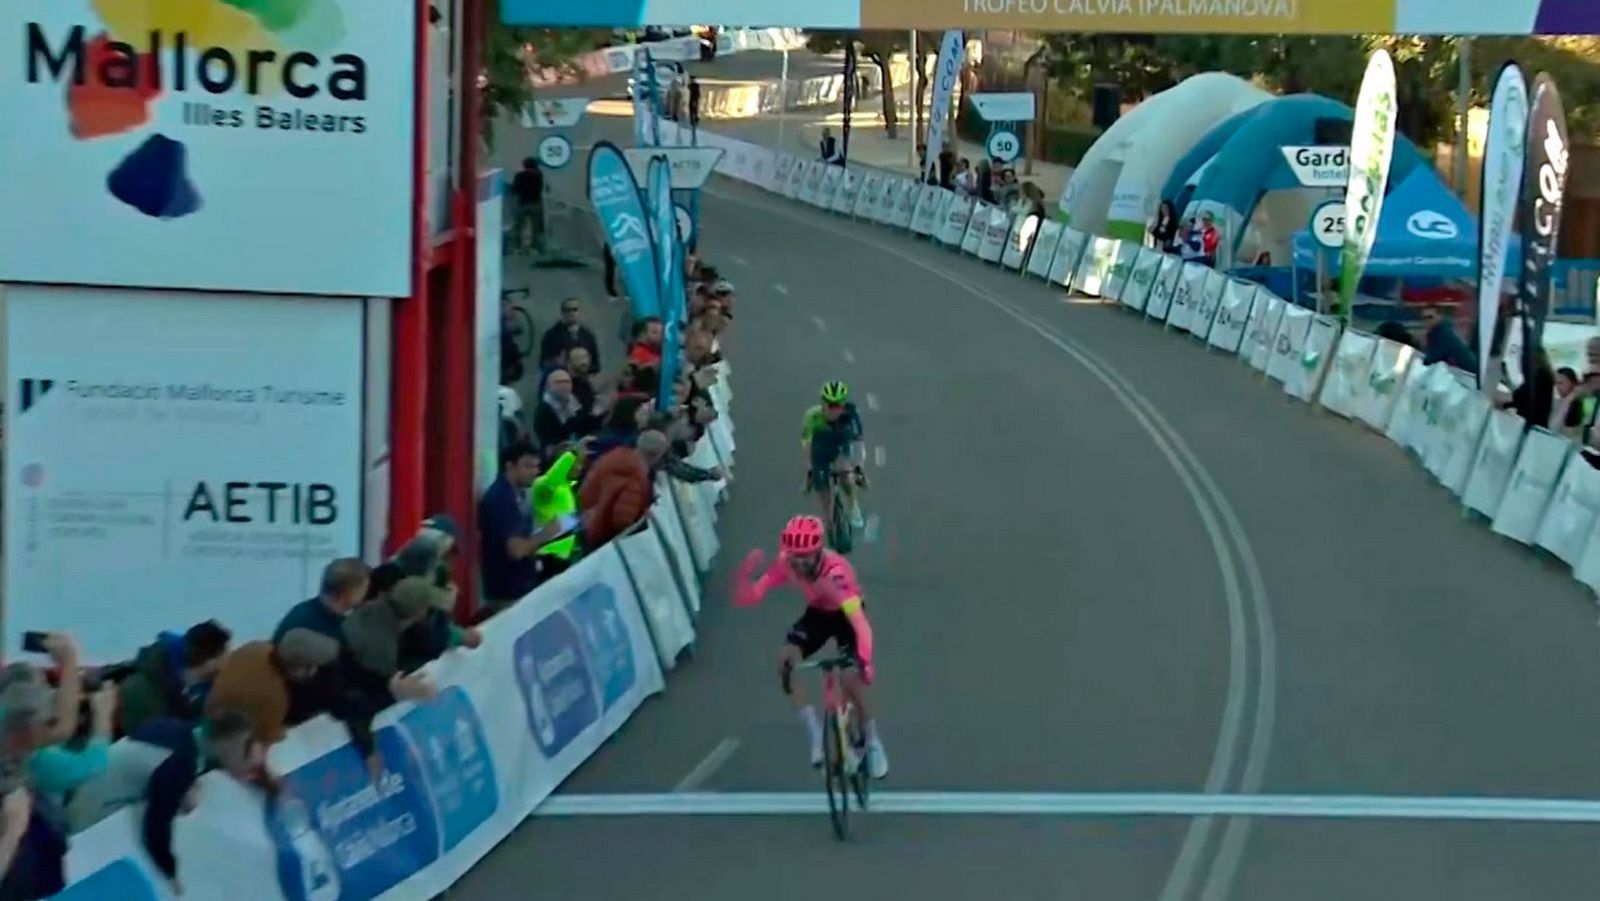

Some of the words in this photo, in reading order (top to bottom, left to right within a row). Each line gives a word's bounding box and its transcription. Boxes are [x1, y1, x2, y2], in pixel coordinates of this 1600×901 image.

[963, 0, 1048, 13] TROFEO
[1138, 0, 1297, 17] (PALMANOVA)
[26, 22, 367, 101] Mallorca
[183, 102, 242, 128] Illes
[255, 105, 367, 134] Balears
[547, 145, 563, 157] 50
[997, 141, 1012, 152] 50
[1295, 148, 1352, 167] Gard
[1312, 168, 1347, 180] hotel
[1323, 216, 1345, 233] 25
[183, 480, 338, 526] AETIB
